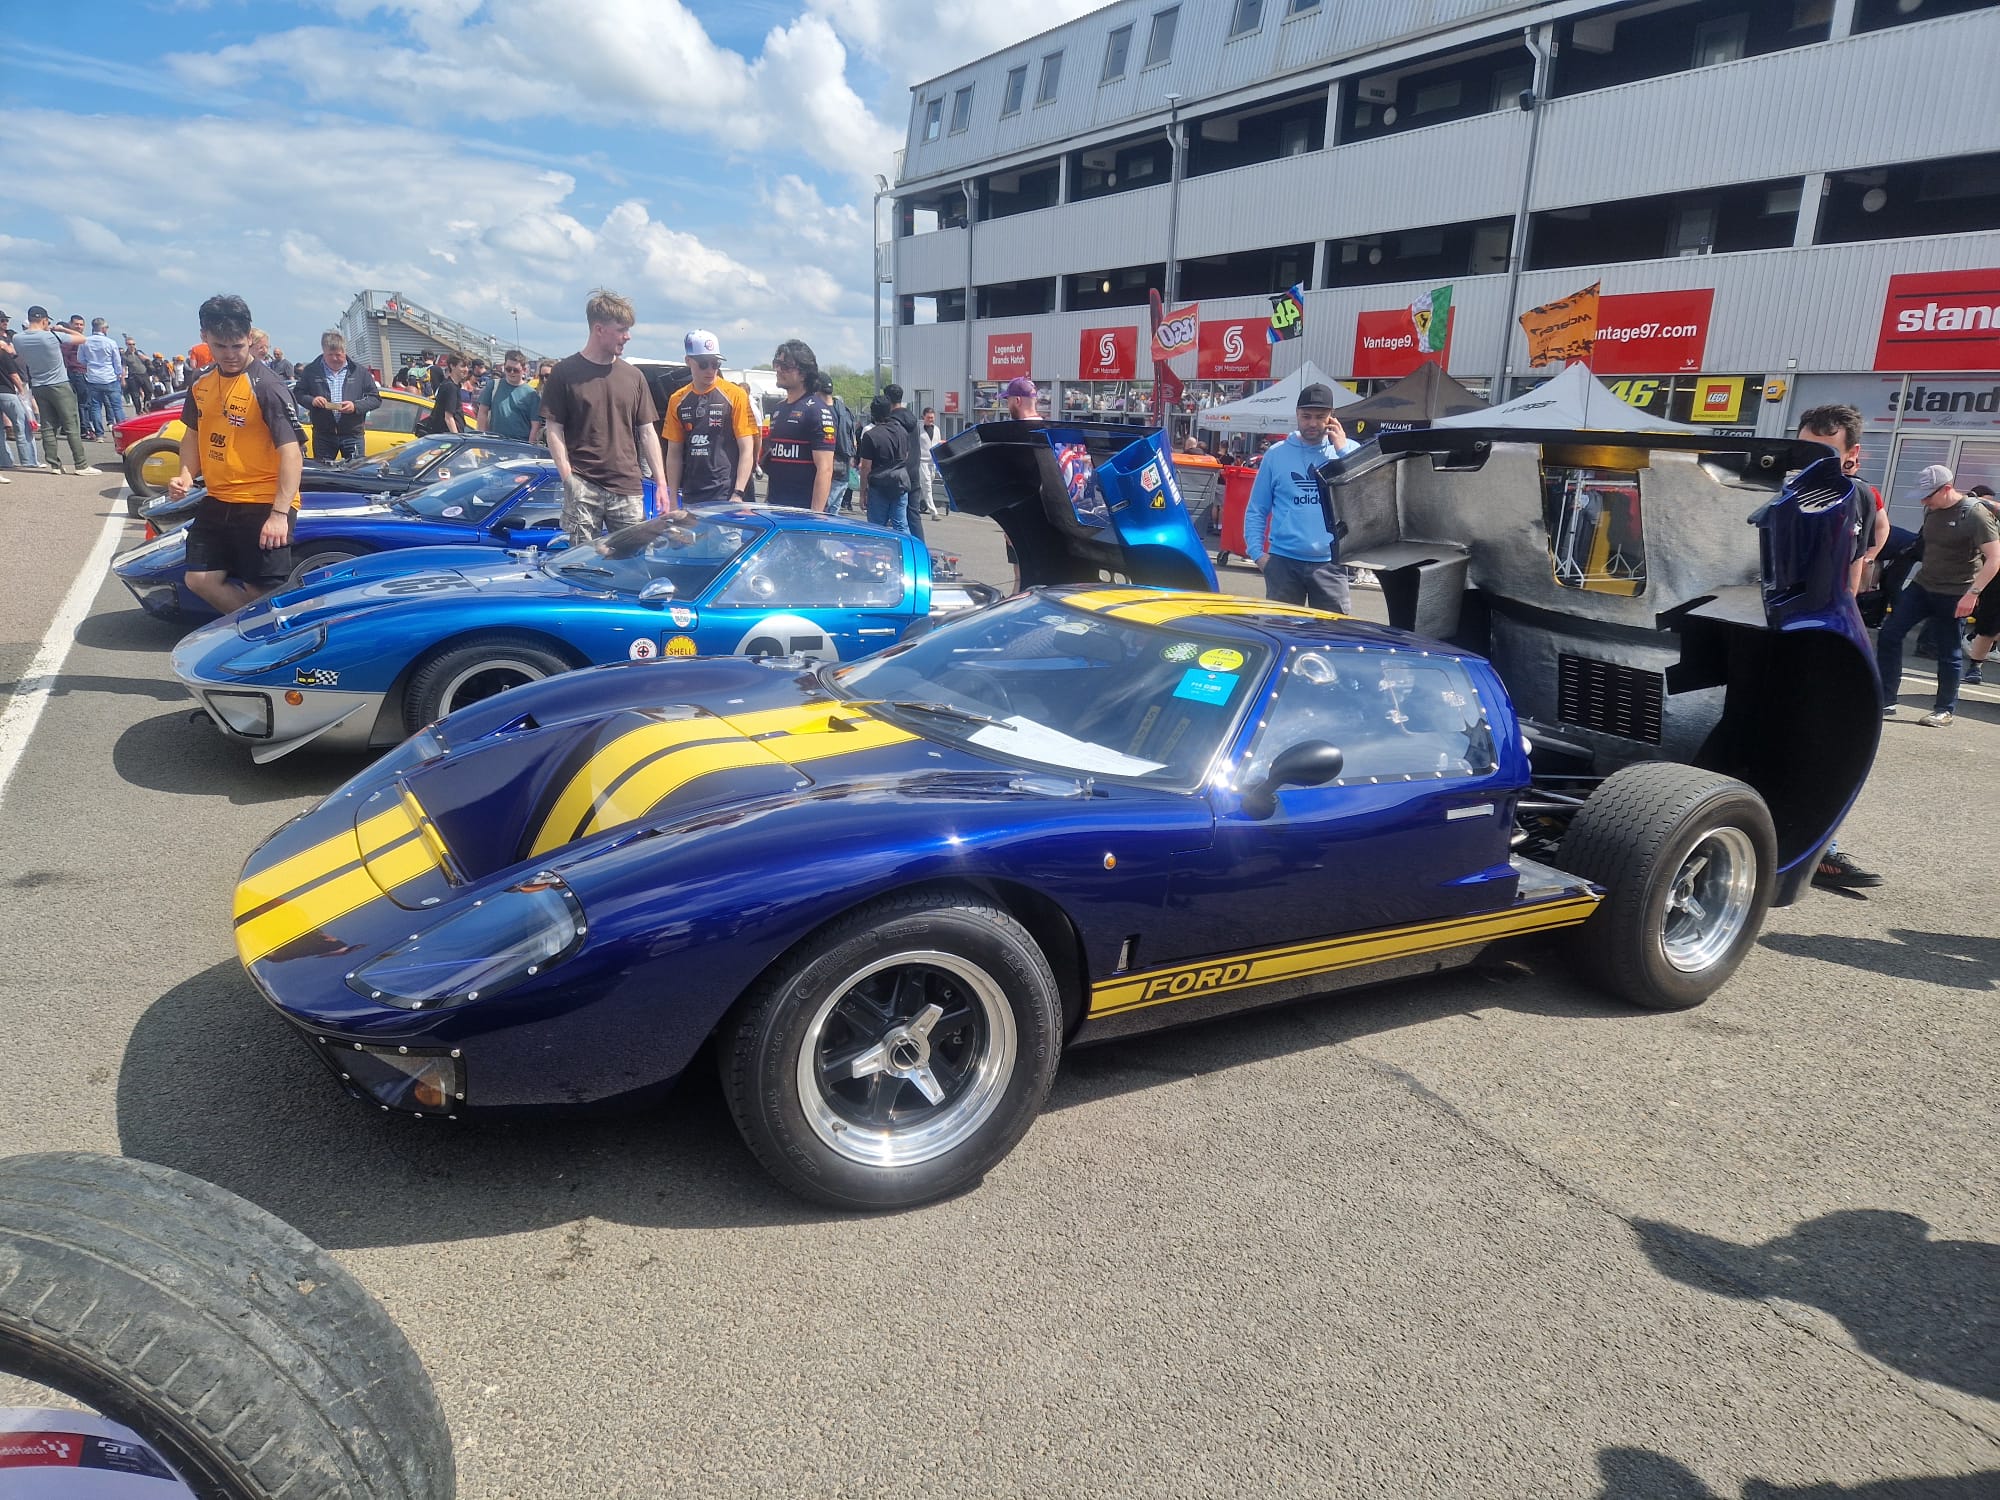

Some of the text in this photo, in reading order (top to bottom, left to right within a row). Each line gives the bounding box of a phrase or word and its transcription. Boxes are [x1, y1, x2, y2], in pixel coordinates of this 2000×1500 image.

[1897, 302, 2000, 332] stan
[1594, 323, 1697, 342] ntage97.com
[1363, 334, 1414, 351] Vantage9
[994, 343, 1023, 356] Legends of
[992, 355, 1025, 365] Brands Hatch
[1224, 364, 1250, 373] Motorsport
[1608, 380, 1660, 407] 46
[1707, 391, 1729, 404] LEGO
[1379, 422, 1413, 431] WILLIAMS
[772, 443, 800, 458] dBull
[1293, 494, 1321, 505] adid
[669, 647, 692, 656] SHELL
[1144, 963, 1248, 1000] FORD
